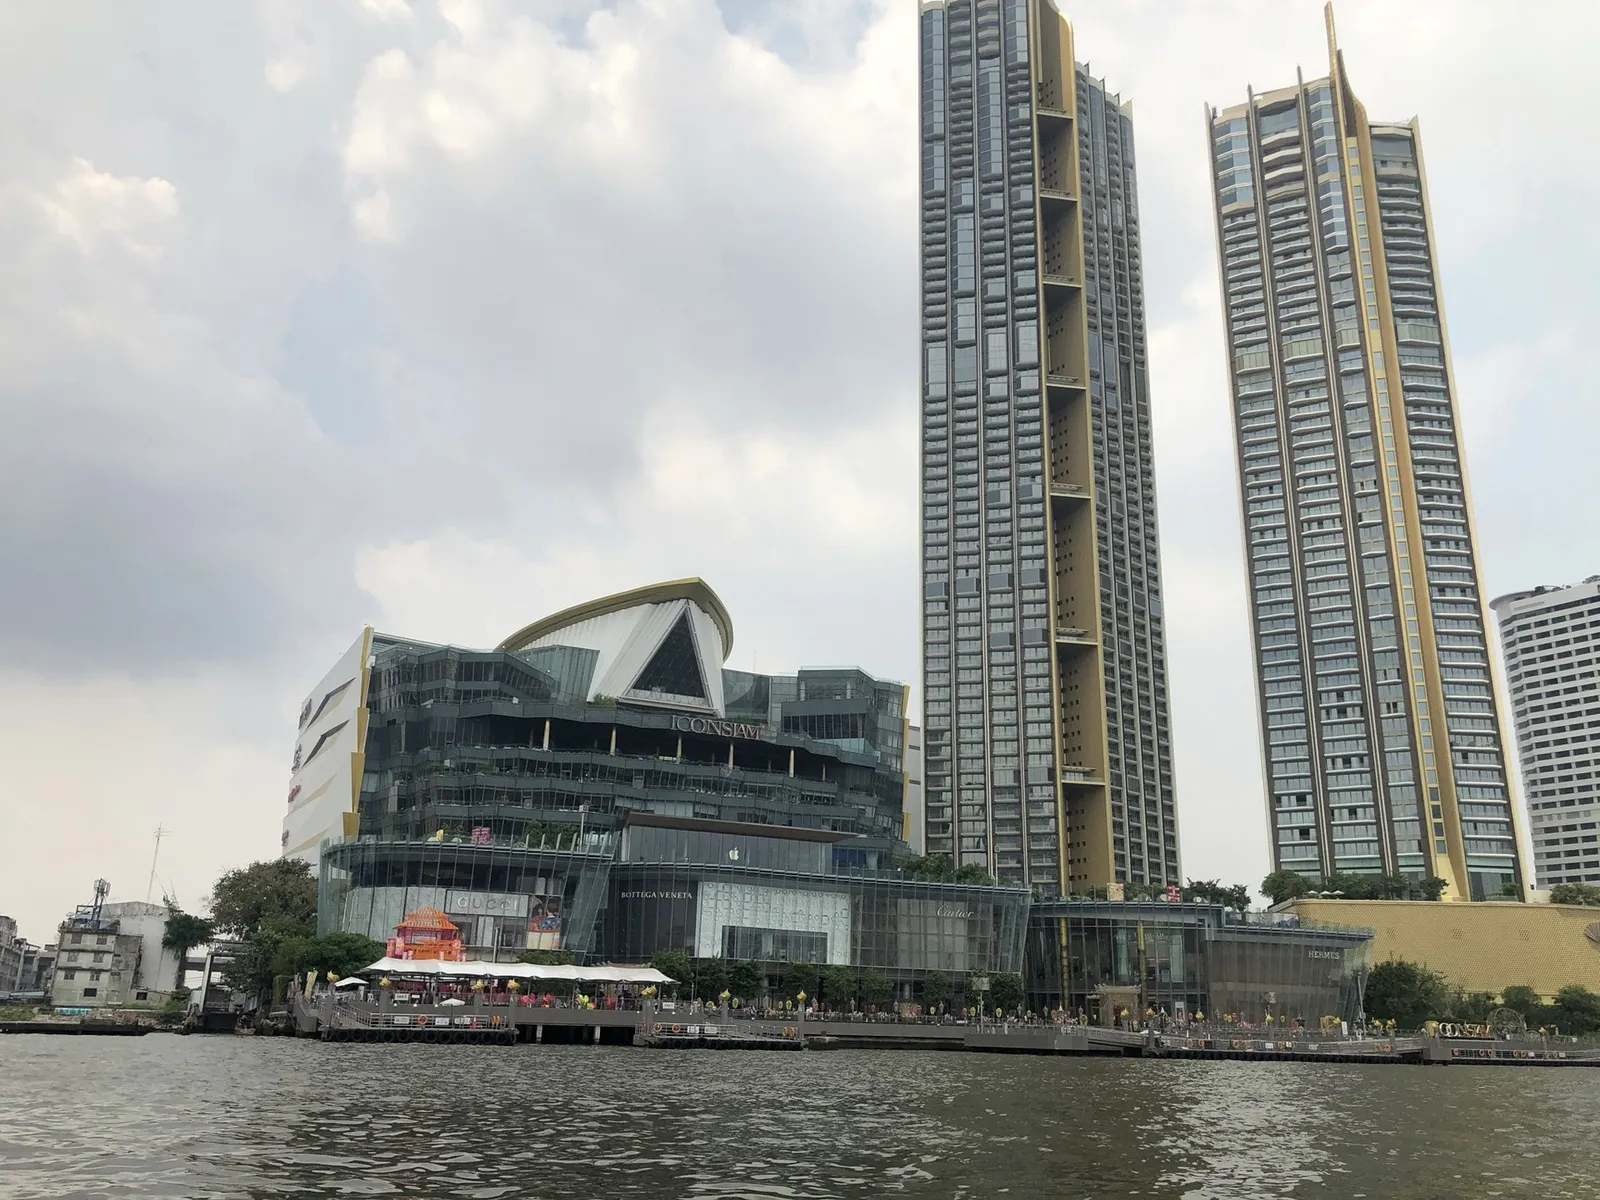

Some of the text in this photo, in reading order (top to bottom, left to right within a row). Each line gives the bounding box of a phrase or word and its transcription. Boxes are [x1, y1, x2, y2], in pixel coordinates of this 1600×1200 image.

[670, 715, 762, 741] ICONSIAM
[621, 891, 657, 899] BOTTEGA
[457, 896, 518, 911] GUCCI
[936, 905, 974, 918] Cartier
